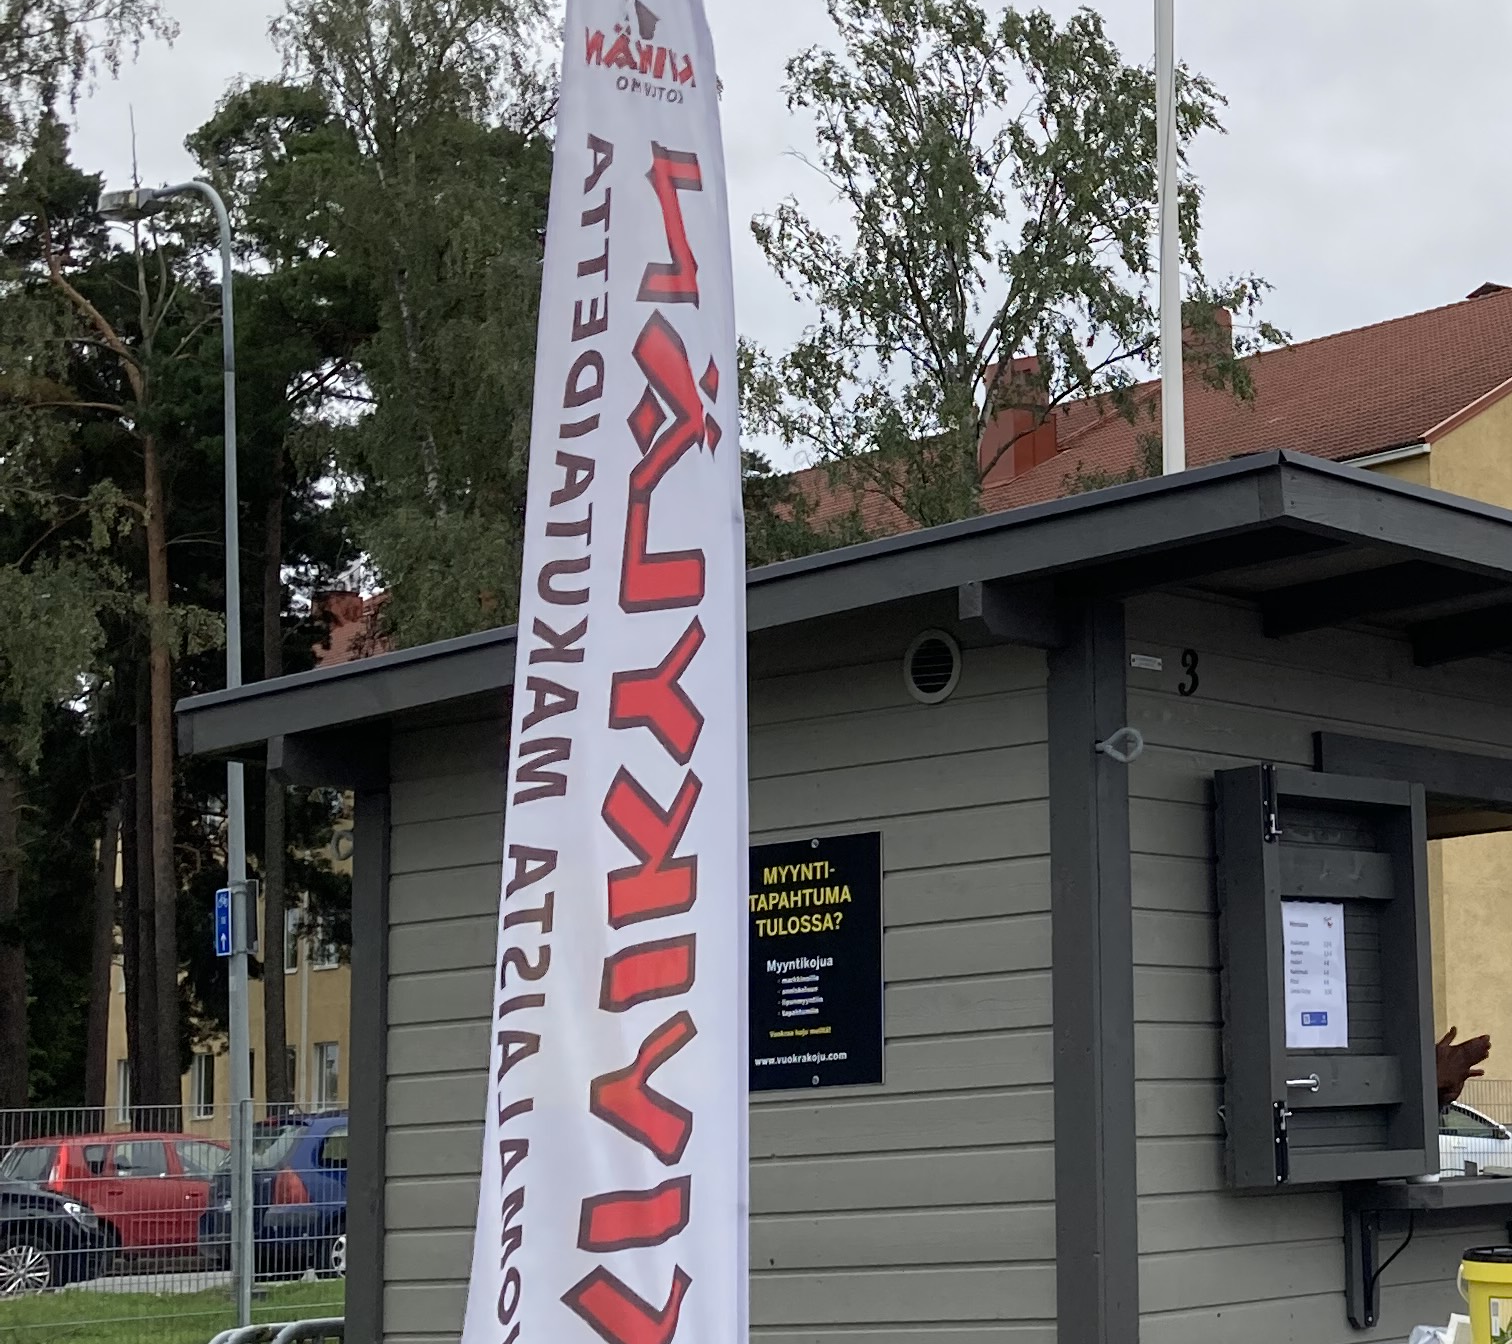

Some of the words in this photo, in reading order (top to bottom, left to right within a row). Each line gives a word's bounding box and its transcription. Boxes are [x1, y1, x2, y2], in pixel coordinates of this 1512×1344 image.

[1178, 648, 1199, 696] 3
[763, 861, 836, 885] MYYNTI-
[749, 885, 852, 913] TAPAHTUMA
[756, 911, 843, 937] TULOSSA?
[766, 955, 834, 975] Myyntikojua
[754, 1050, 848, 1068] www.vuokrakoju.com
